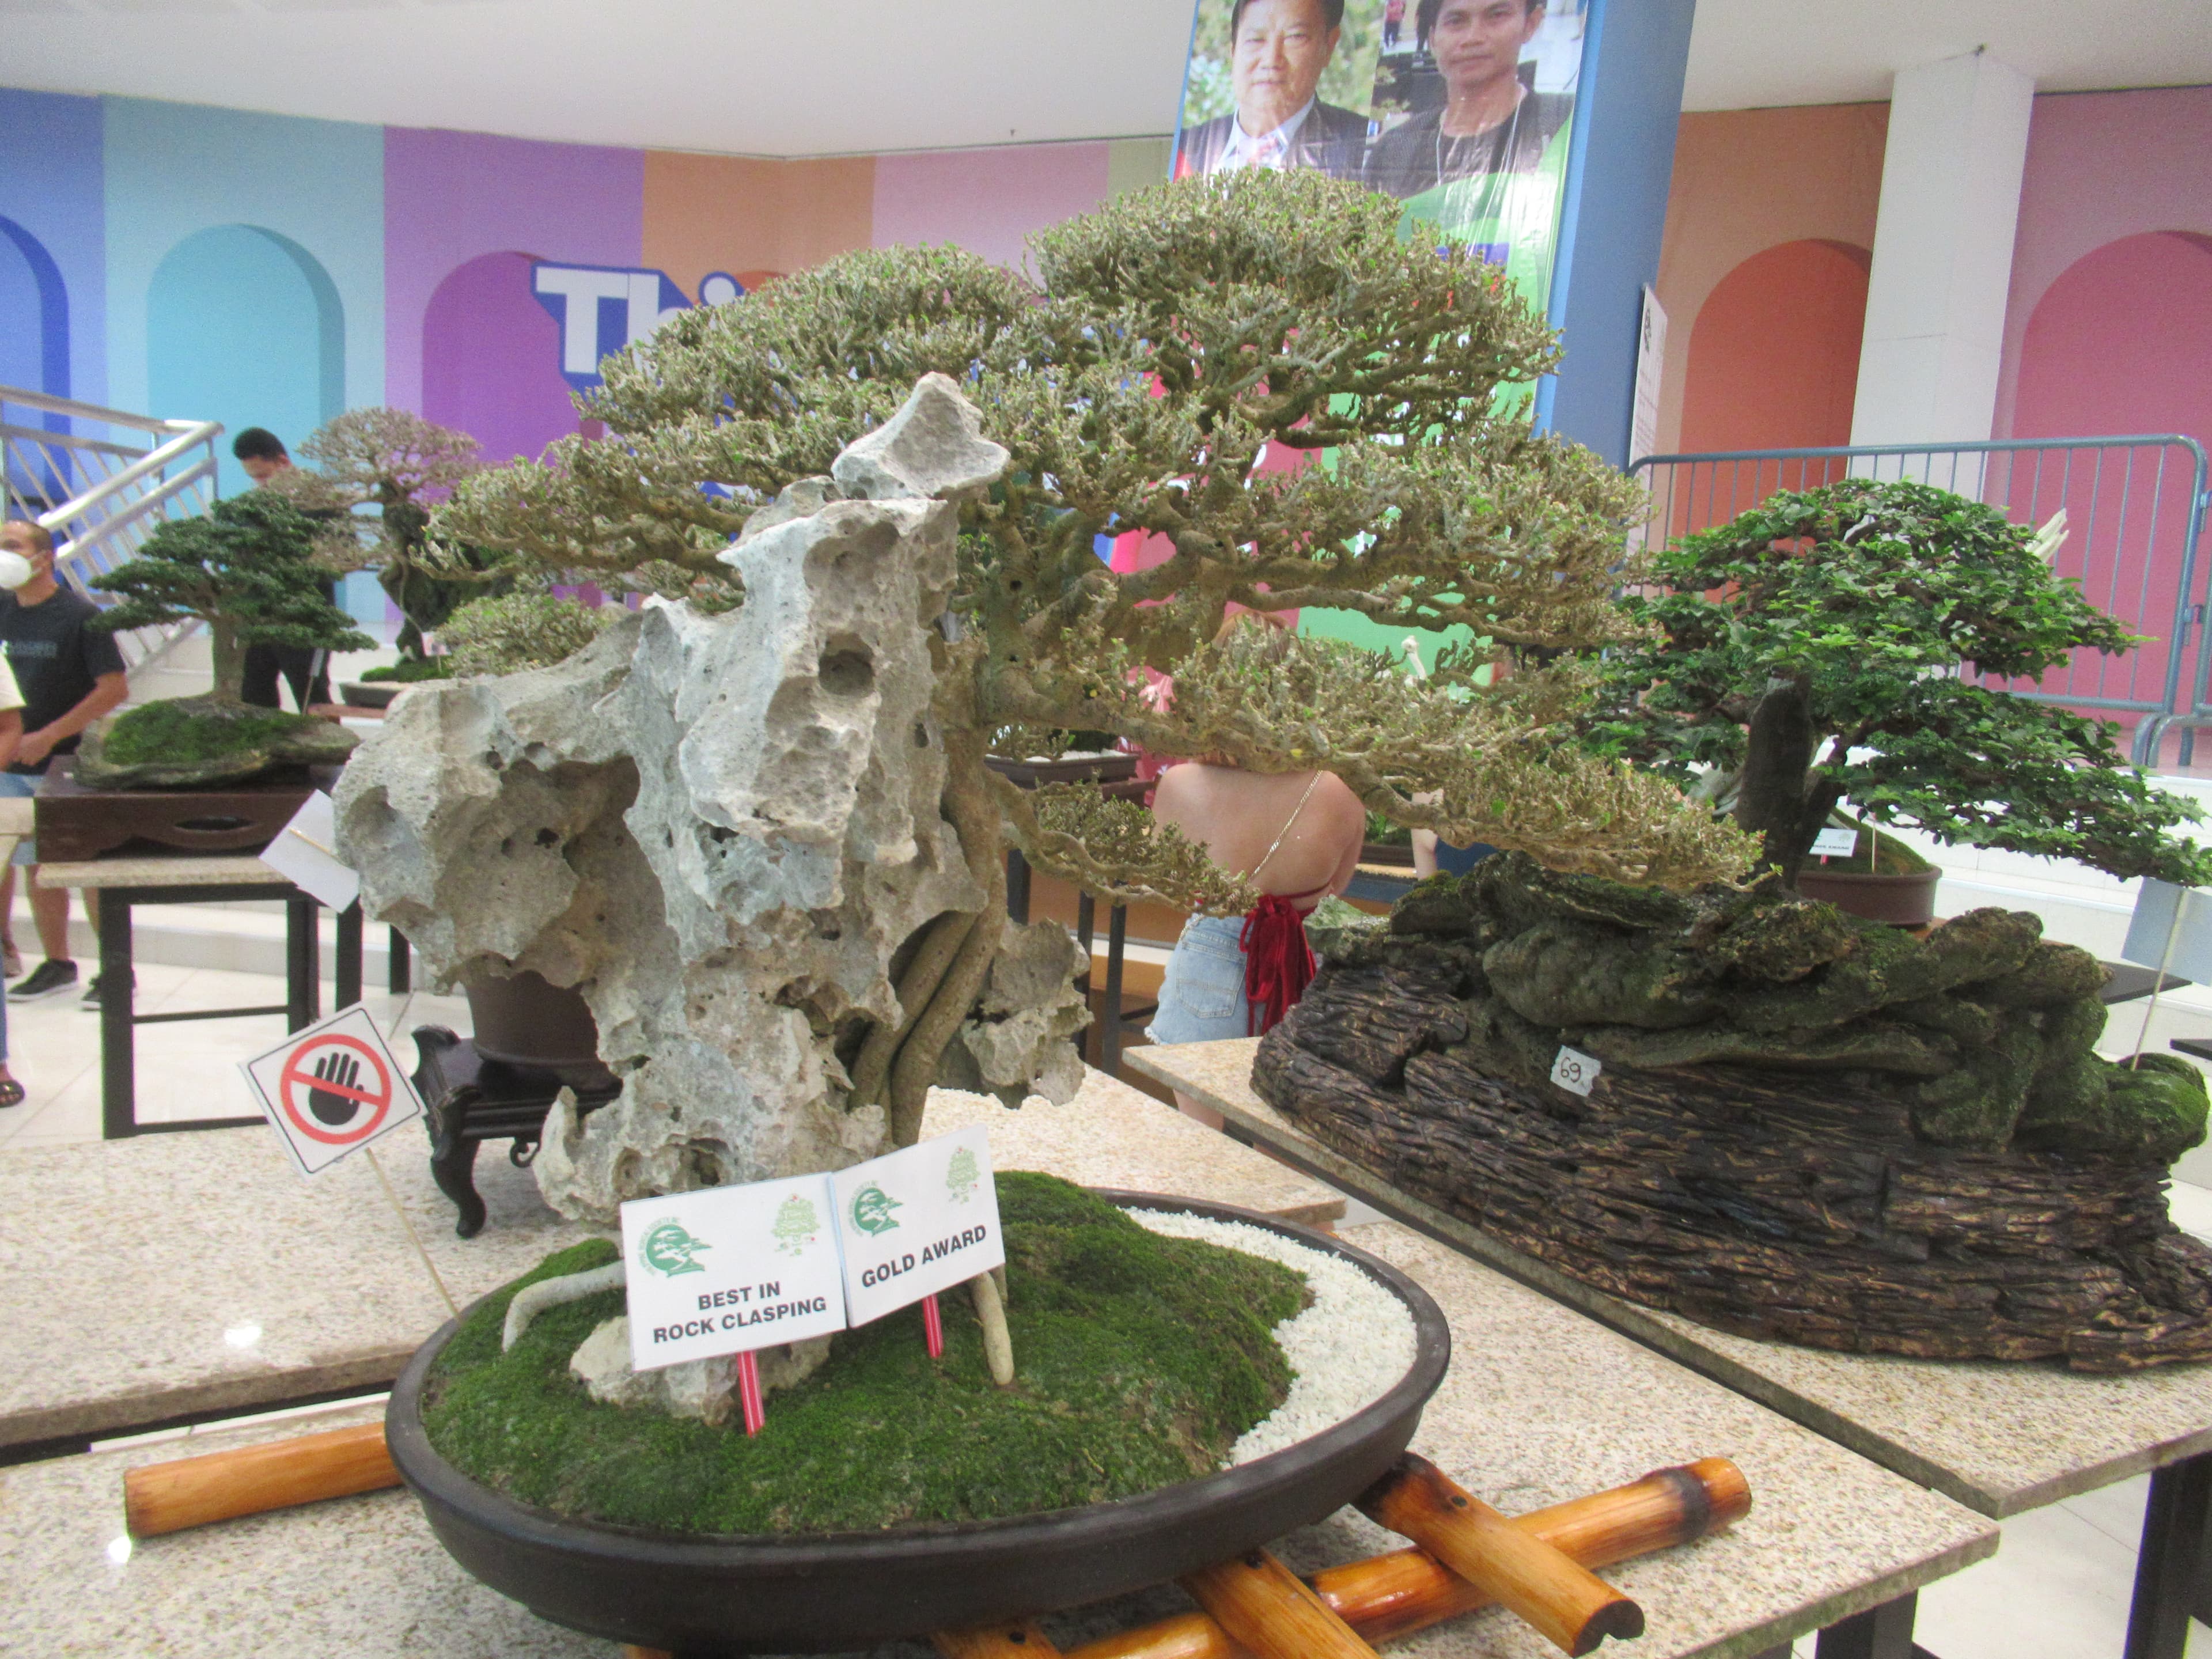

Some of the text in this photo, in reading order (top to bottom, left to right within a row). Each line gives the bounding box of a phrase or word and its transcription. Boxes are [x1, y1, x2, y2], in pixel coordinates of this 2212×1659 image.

[1560, 1056, 1581, 1082] 69
[862, 1225, 986, 1287] GOLD AWARD
[698, 1281, 781, 1310] BEST IN
[653, 1297, 826, 1343] ROCK CLASPING
